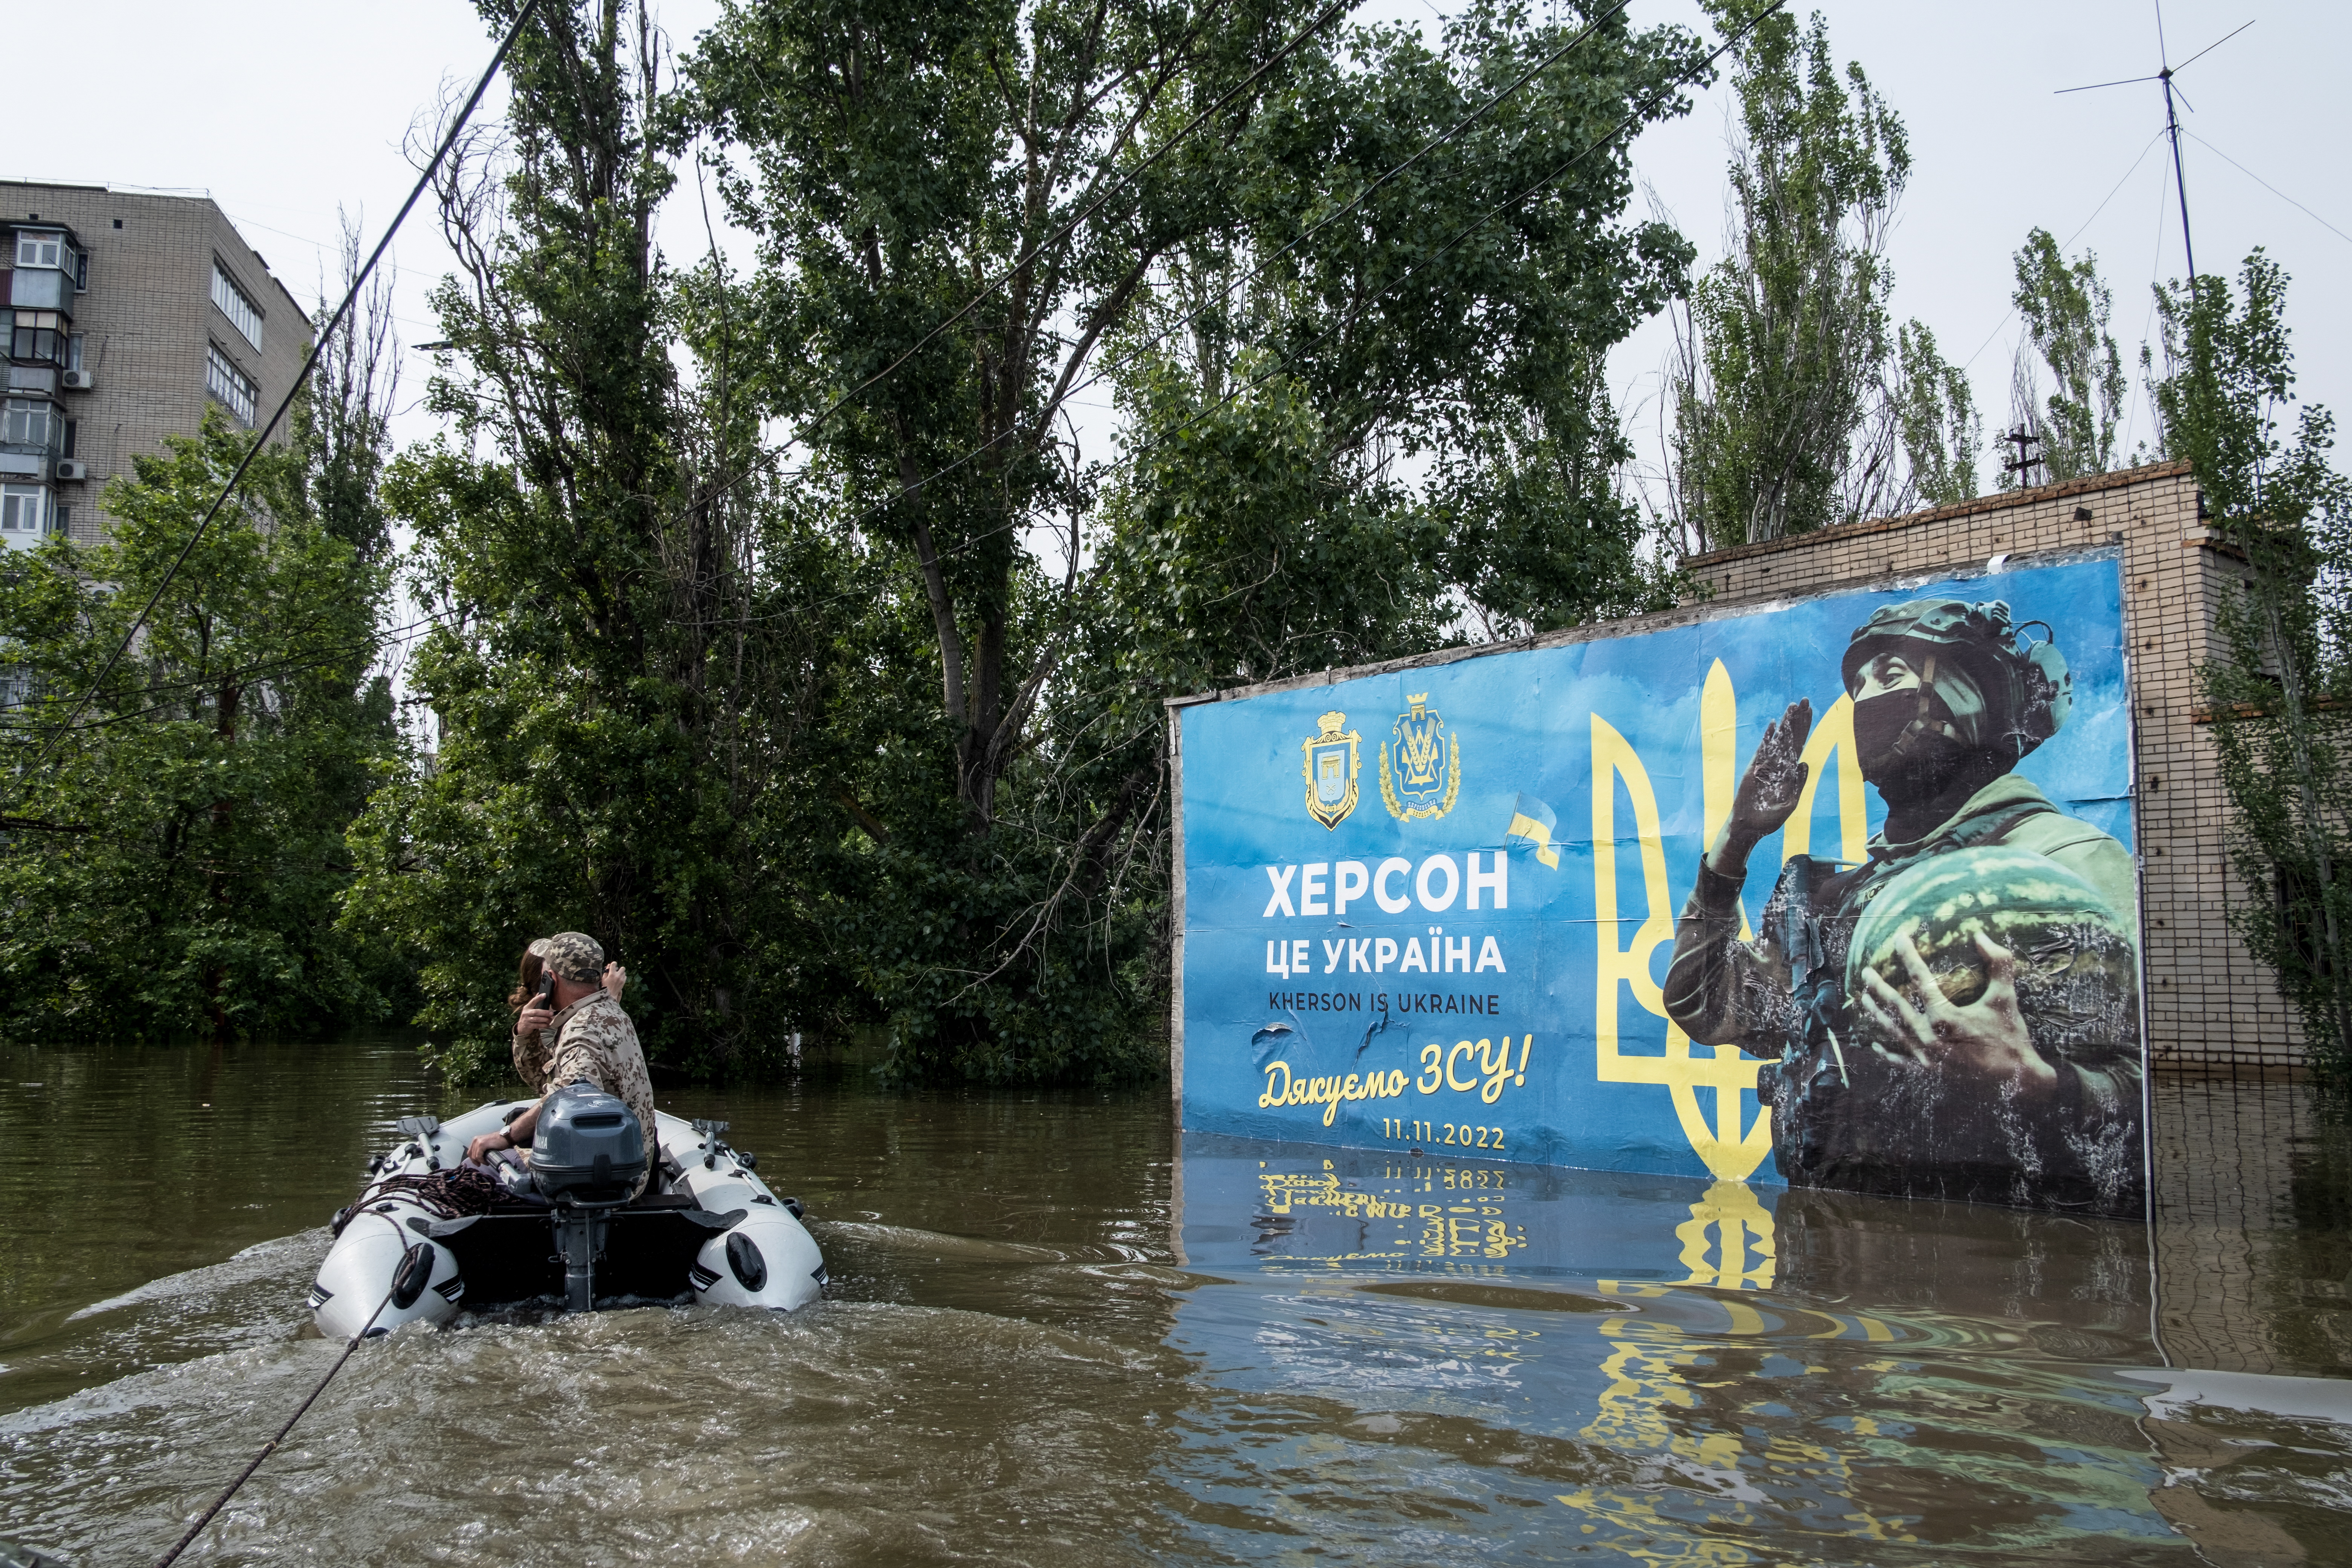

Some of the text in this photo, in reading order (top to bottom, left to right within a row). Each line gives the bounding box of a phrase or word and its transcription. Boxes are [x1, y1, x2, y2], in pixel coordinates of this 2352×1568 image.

[1262, 851, 1508, 917] ХЕРСОН
[1266, 926, 1507, 979] ЦЕ УКРАЇНА
[1269, 992, 1499, 1015] KHERSON IS UKRAINE
[1259, 1034, 1533, 1127] Дякуємо ЗСУ!
[1383, 1118, 1504, 1149] 11.11.2022
